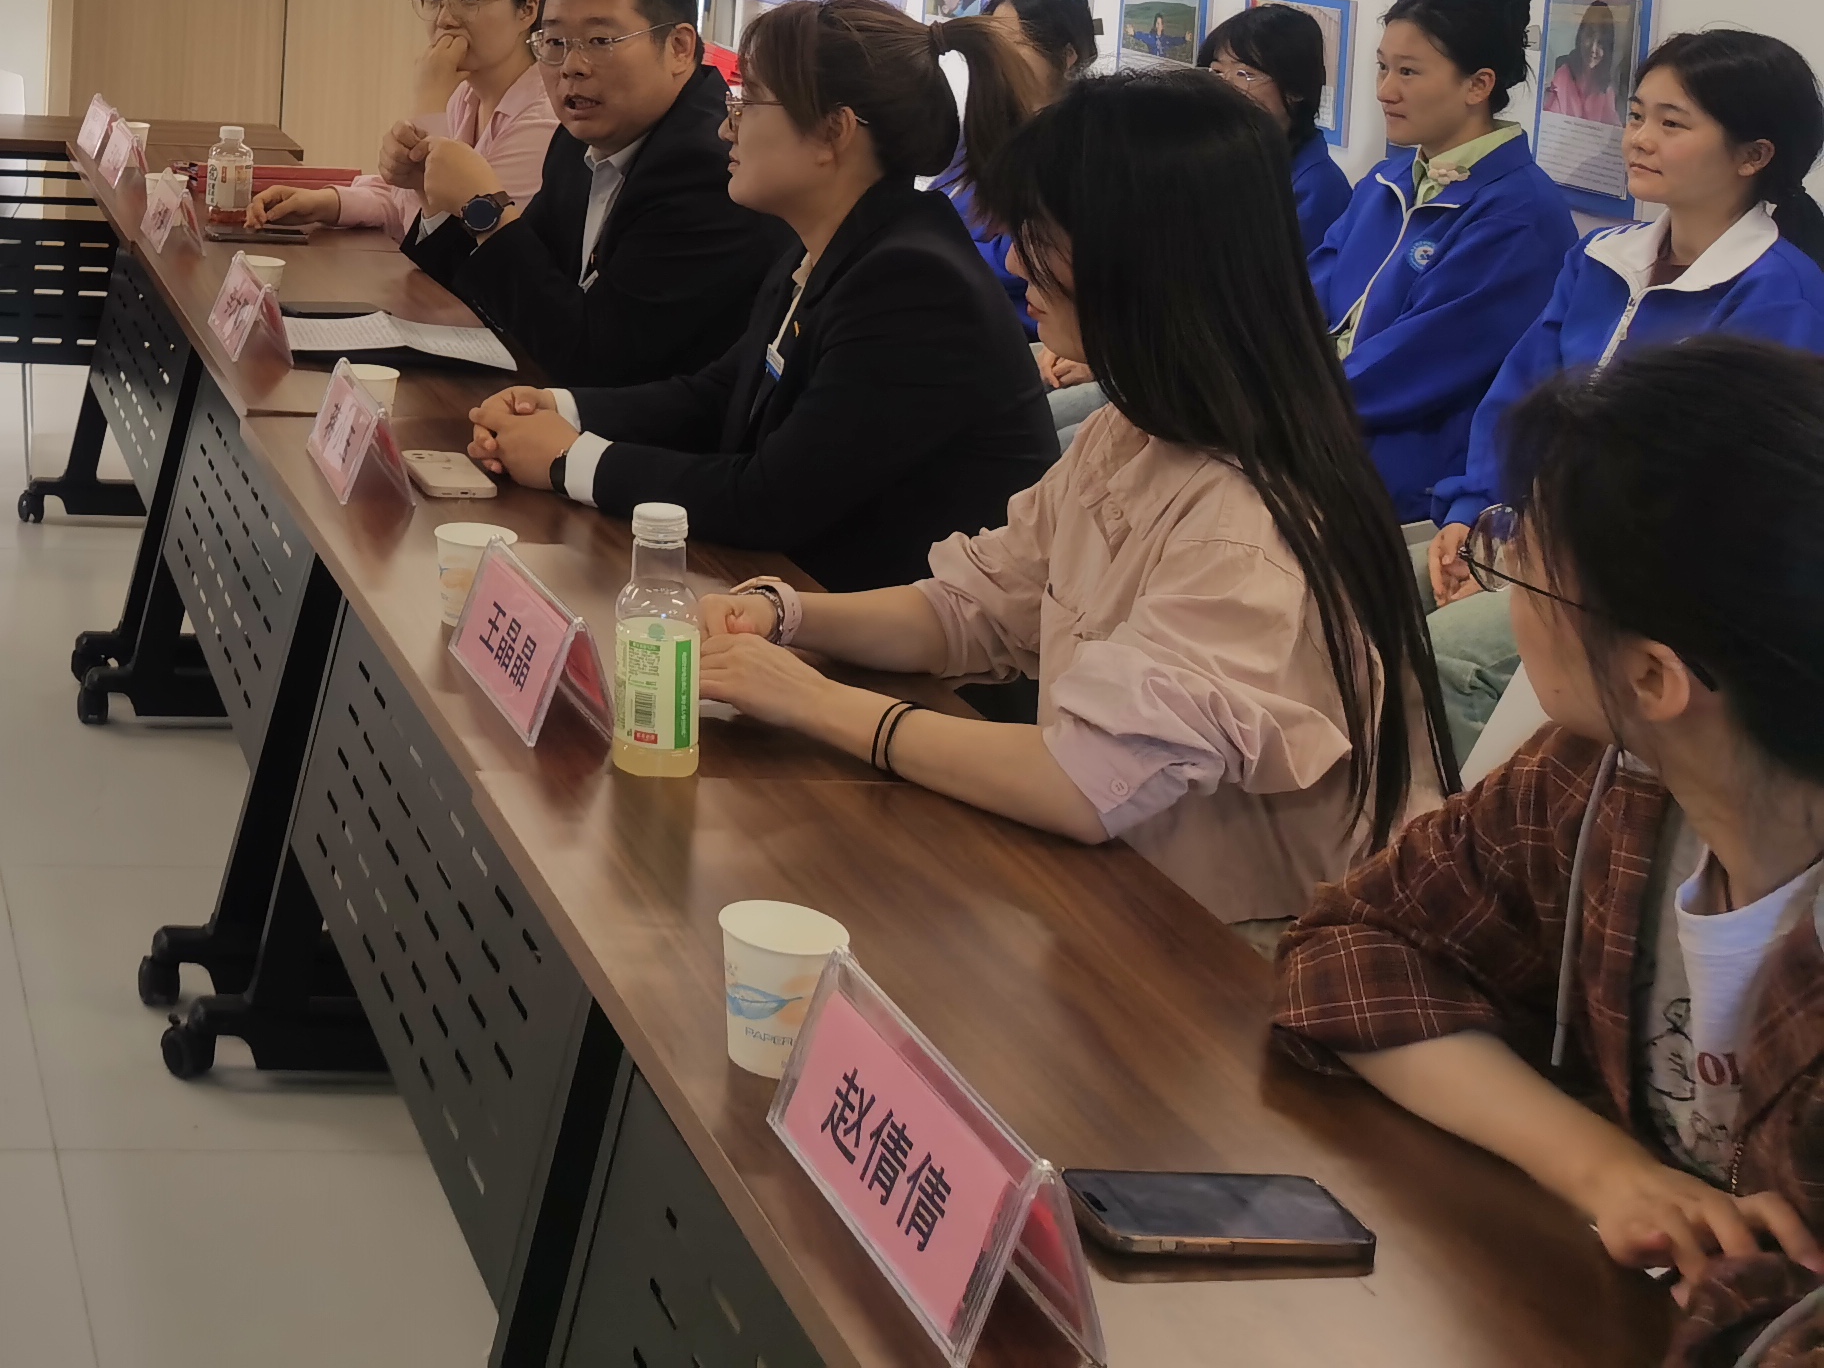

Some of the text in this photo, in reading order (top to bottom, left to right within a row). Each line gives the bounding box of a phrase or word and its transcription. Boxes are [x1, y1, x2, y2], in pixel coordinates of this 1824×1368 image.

[479, 600, 537, 693] 王晶晶
[820, 1067, 953, 1252] 赵倩倩
